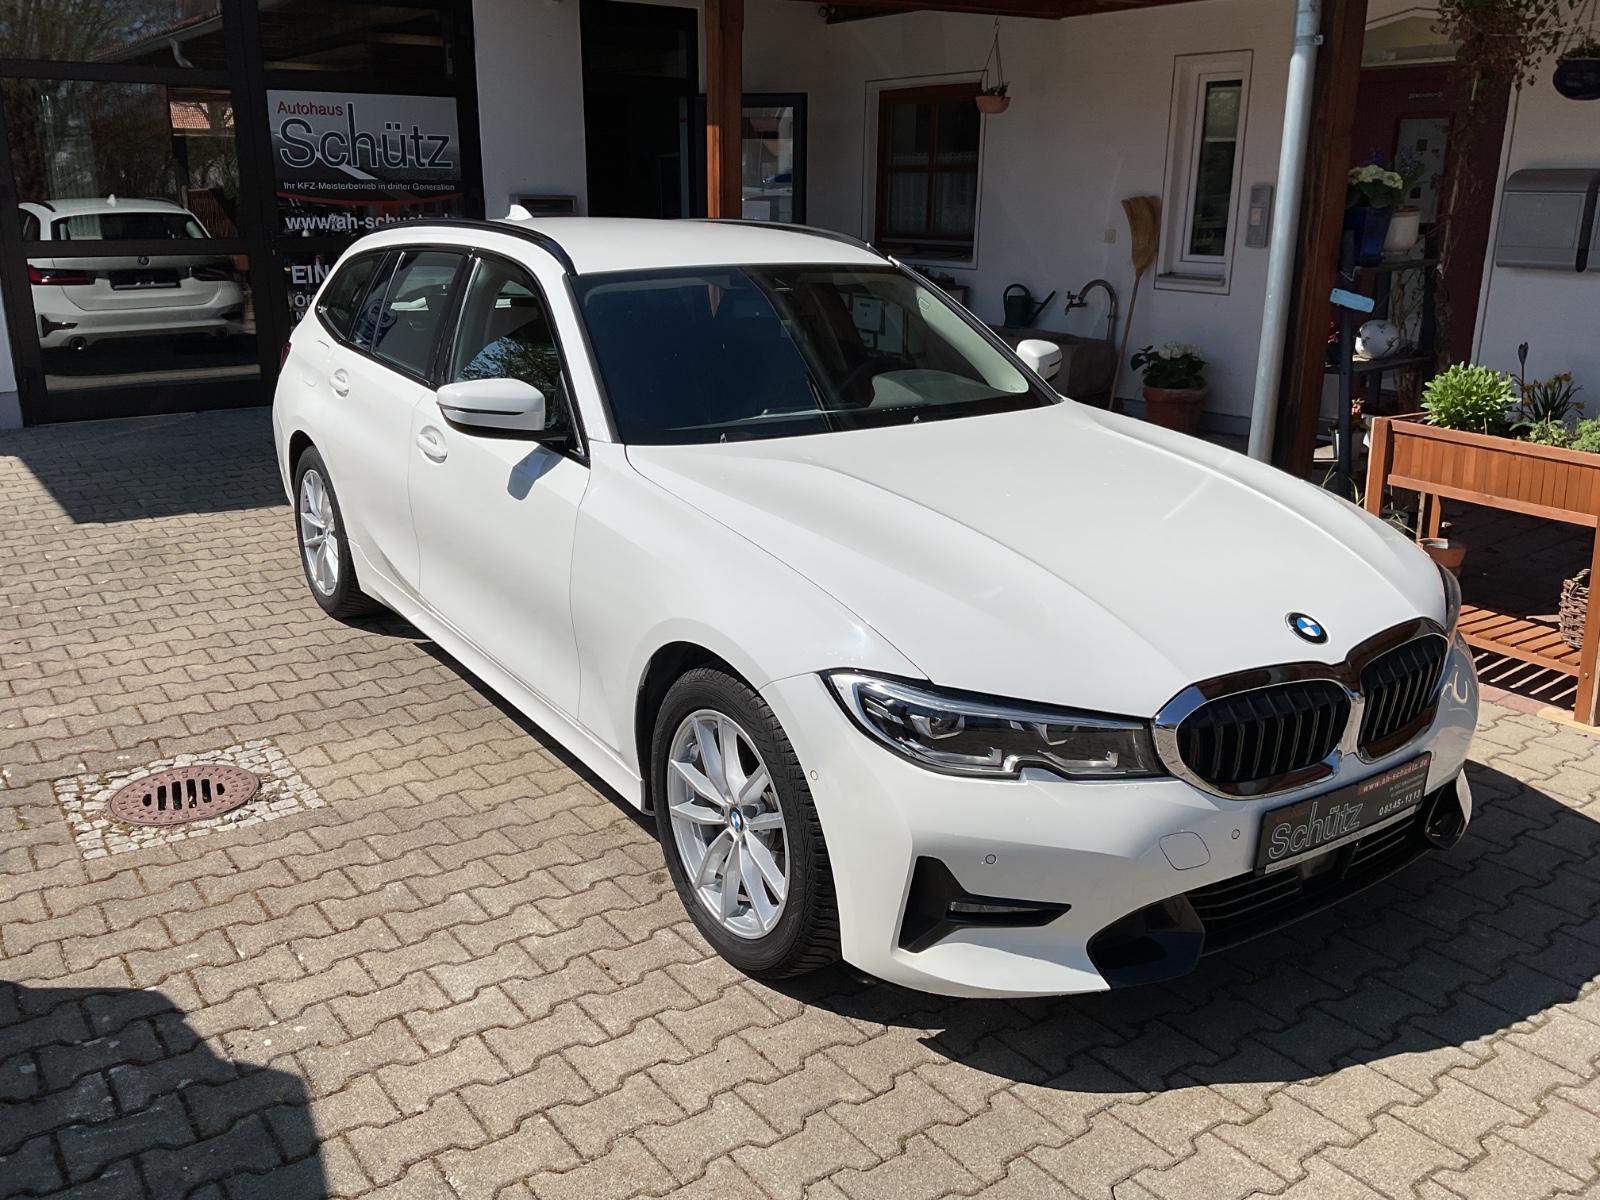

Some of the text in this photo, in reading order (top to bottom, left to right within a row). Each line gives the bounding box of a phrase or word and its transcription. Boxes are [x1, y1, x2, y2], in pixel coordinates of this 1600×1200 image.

[277, 101, 344, 117] Autohaus
[280, 102, 453, 168] Schütz
[283, 182, 455, 191] Ihr KFZ-Meisterbetrieb in dritter Generation
[1269, 801, 1364, 860] Schütz
